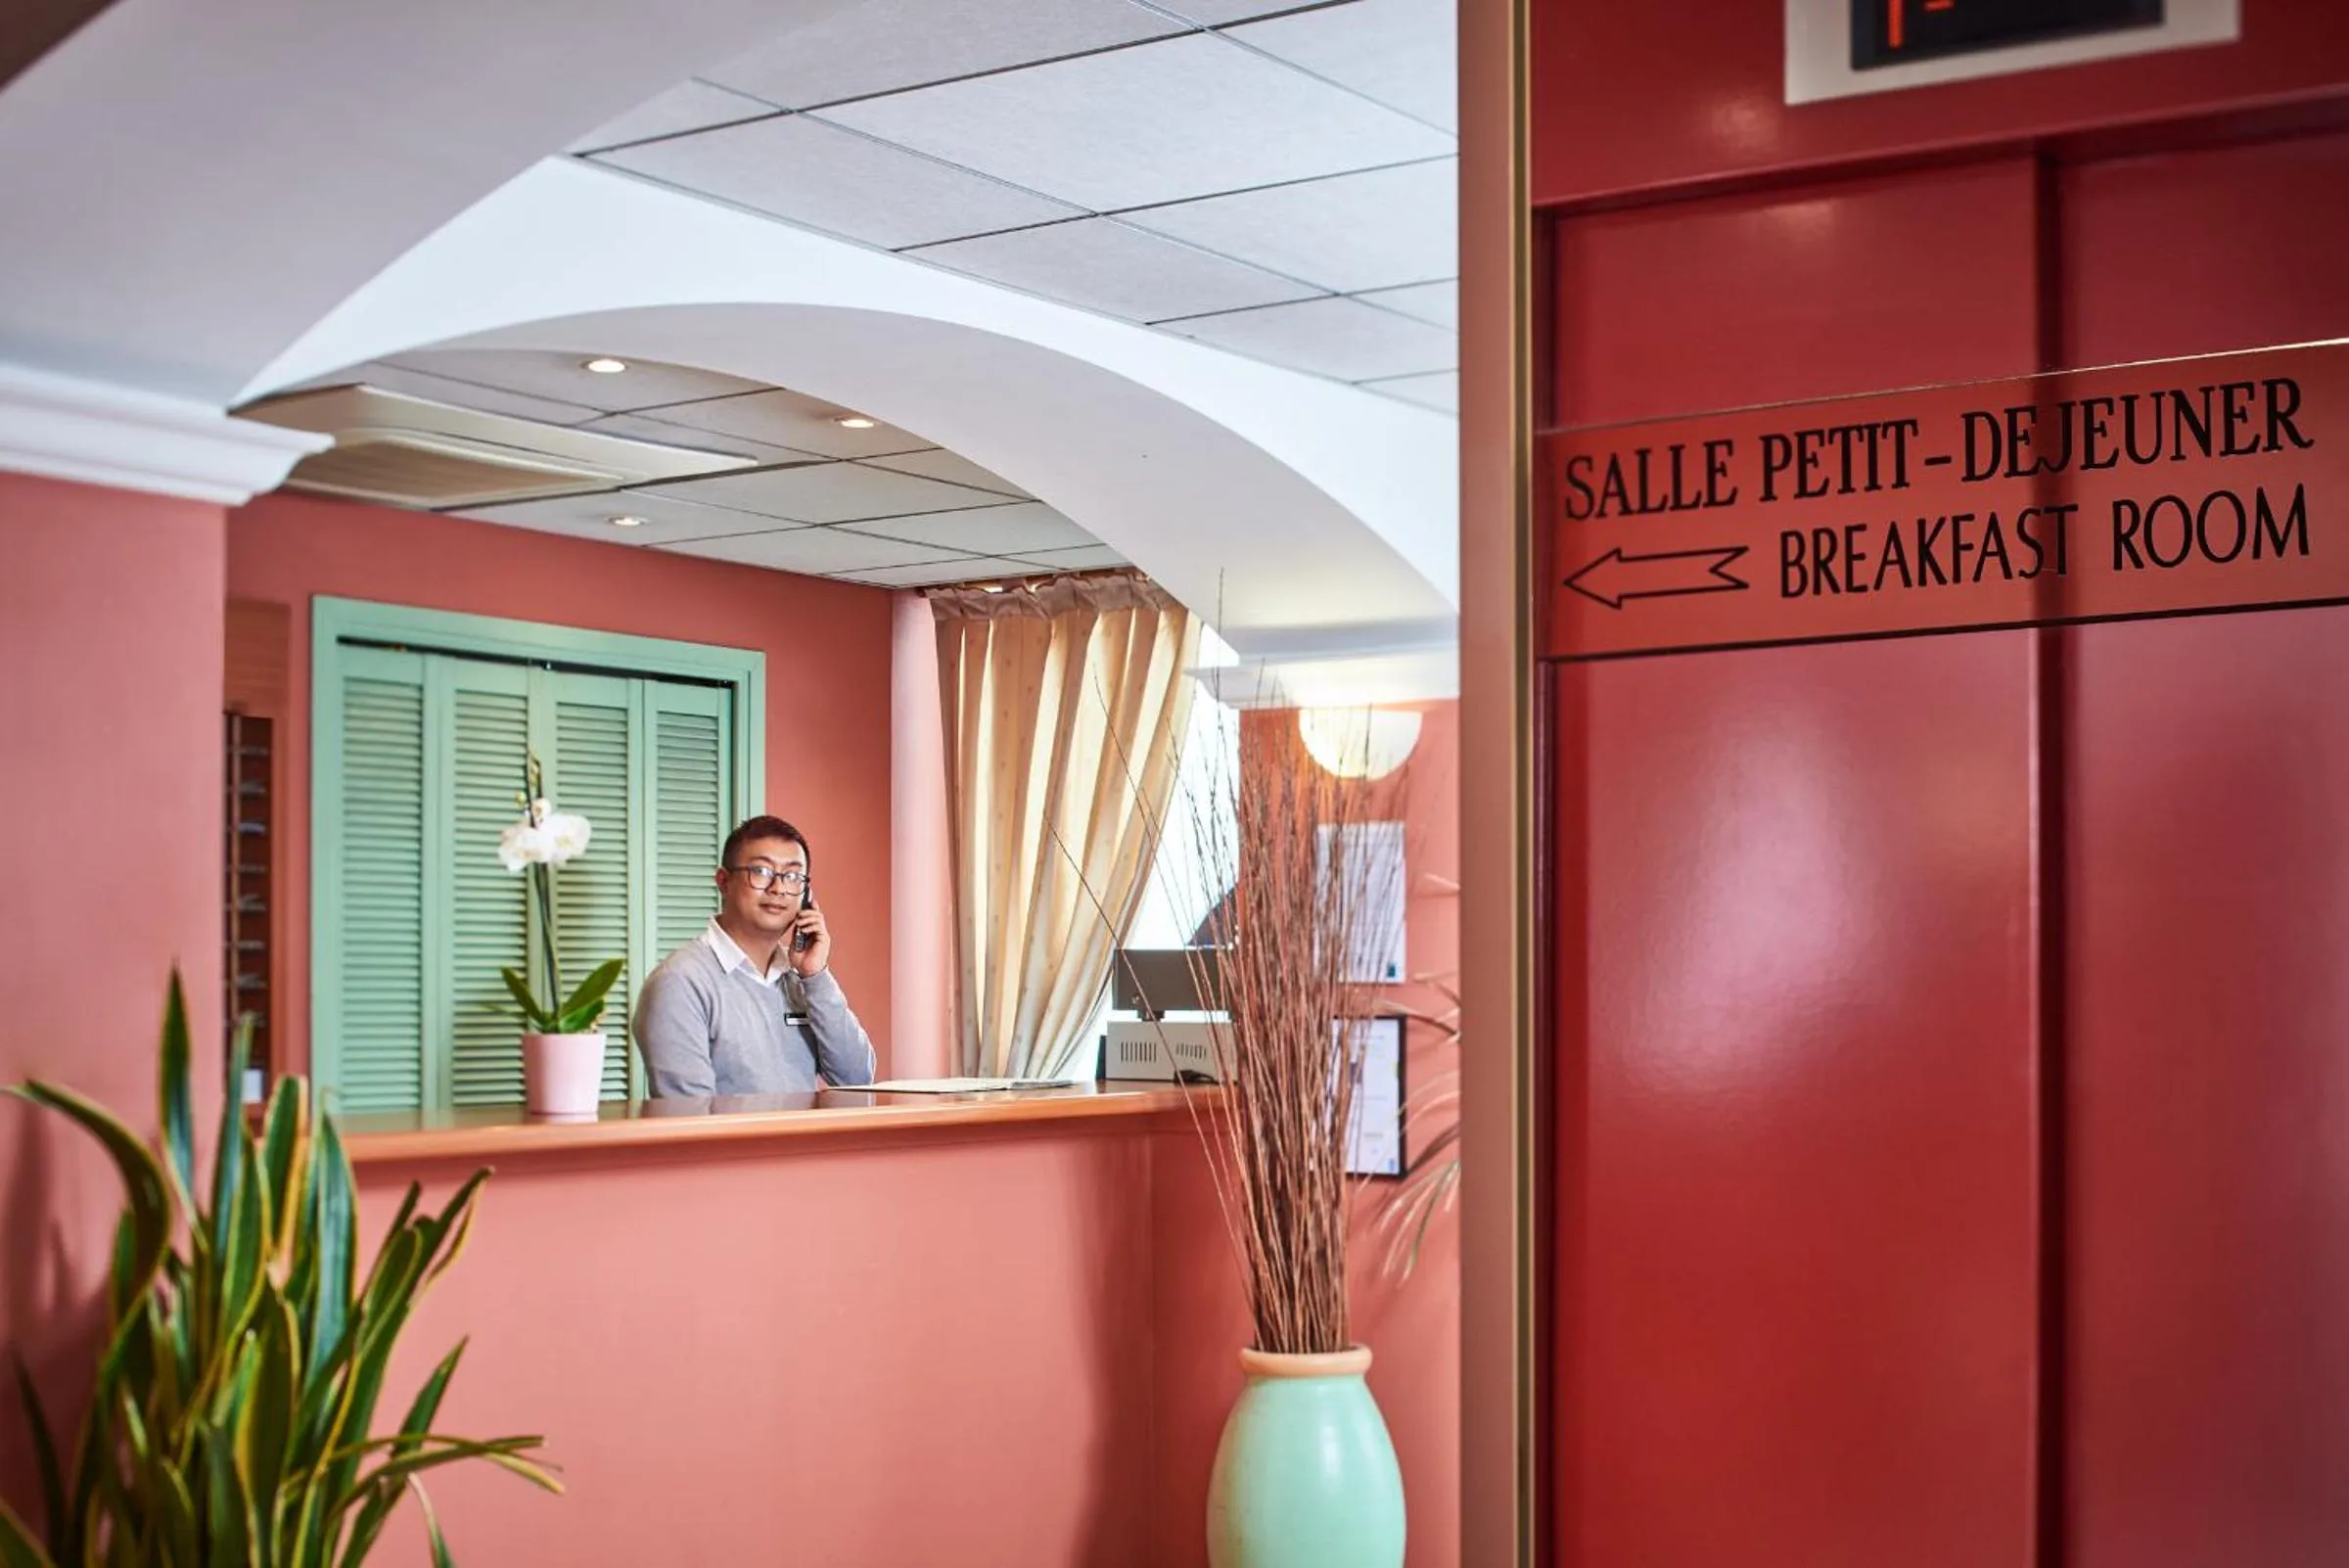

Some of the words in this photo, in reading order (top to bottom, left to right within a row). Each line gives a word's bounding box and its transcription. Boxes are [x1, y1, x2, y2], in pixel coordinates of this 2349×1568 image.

[1565, 439, 1738, 520] SALLE
[1780, 504, 2079, 598] BREAKFAST
[2112, 484, 2311, 571] ROOM
